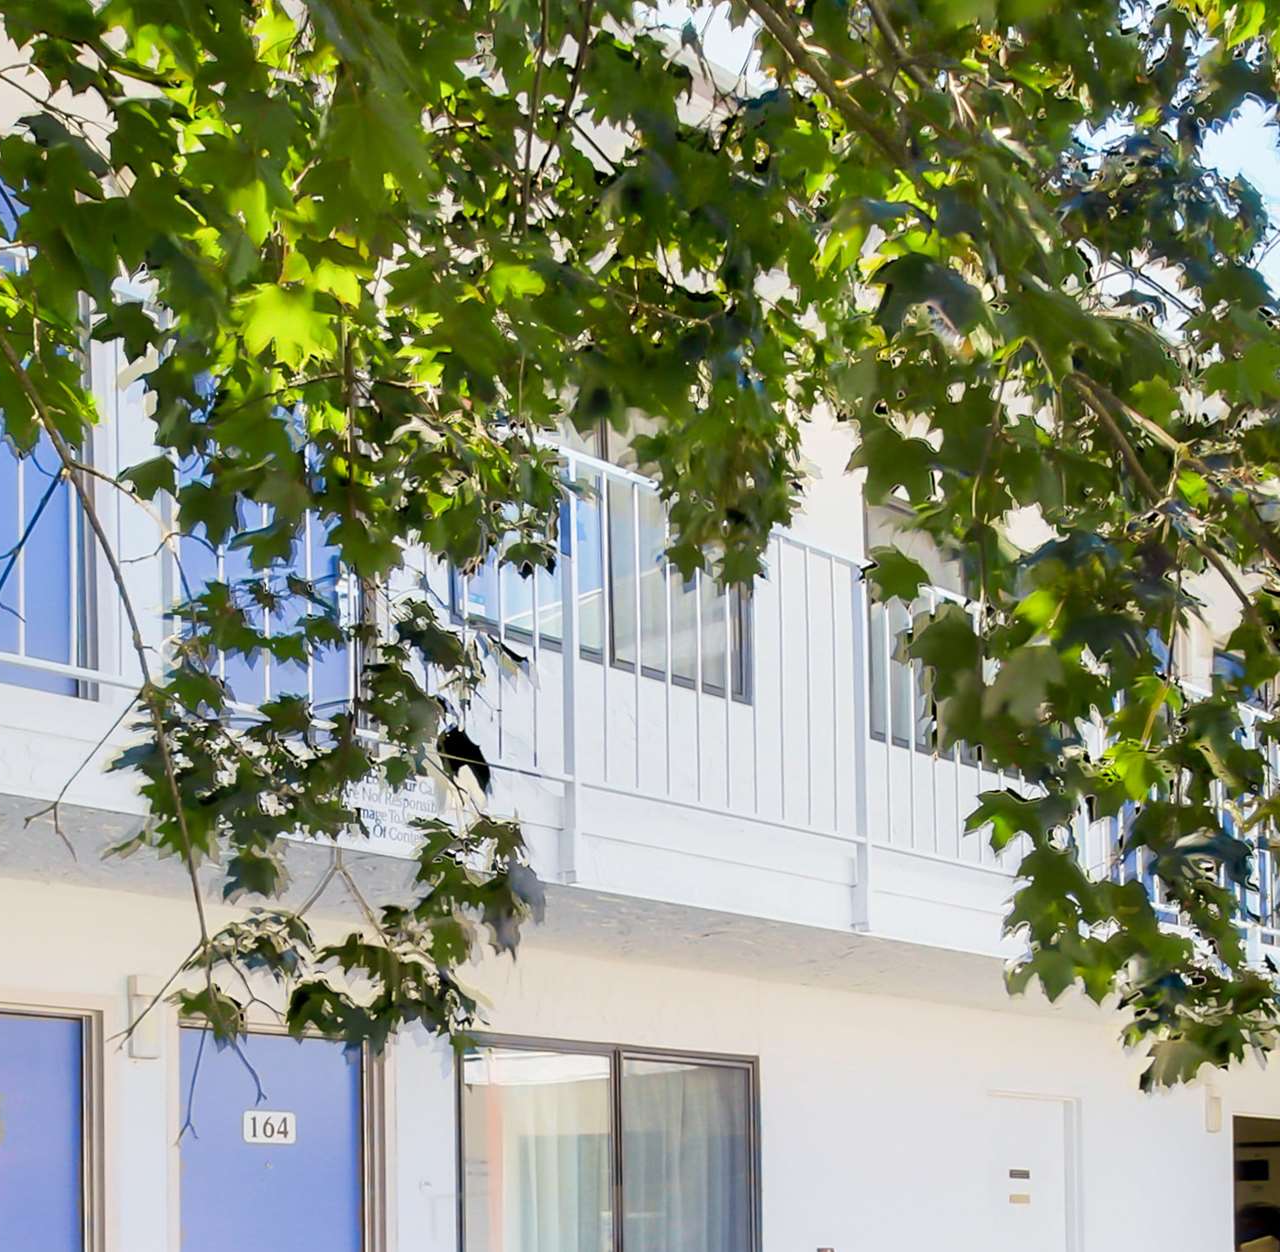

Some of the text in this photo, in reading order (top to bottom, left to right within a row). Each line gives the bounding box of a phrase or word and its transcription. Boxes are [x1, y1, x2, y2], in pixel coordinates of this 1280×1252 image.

[361, 786, 383, 803] Not
[385, 791, 439, 813] Responsib
[359, 807, 387, 827] mage
[388, 826, 425, 843] Conte
[251, 1116, 289, 1139] 164
